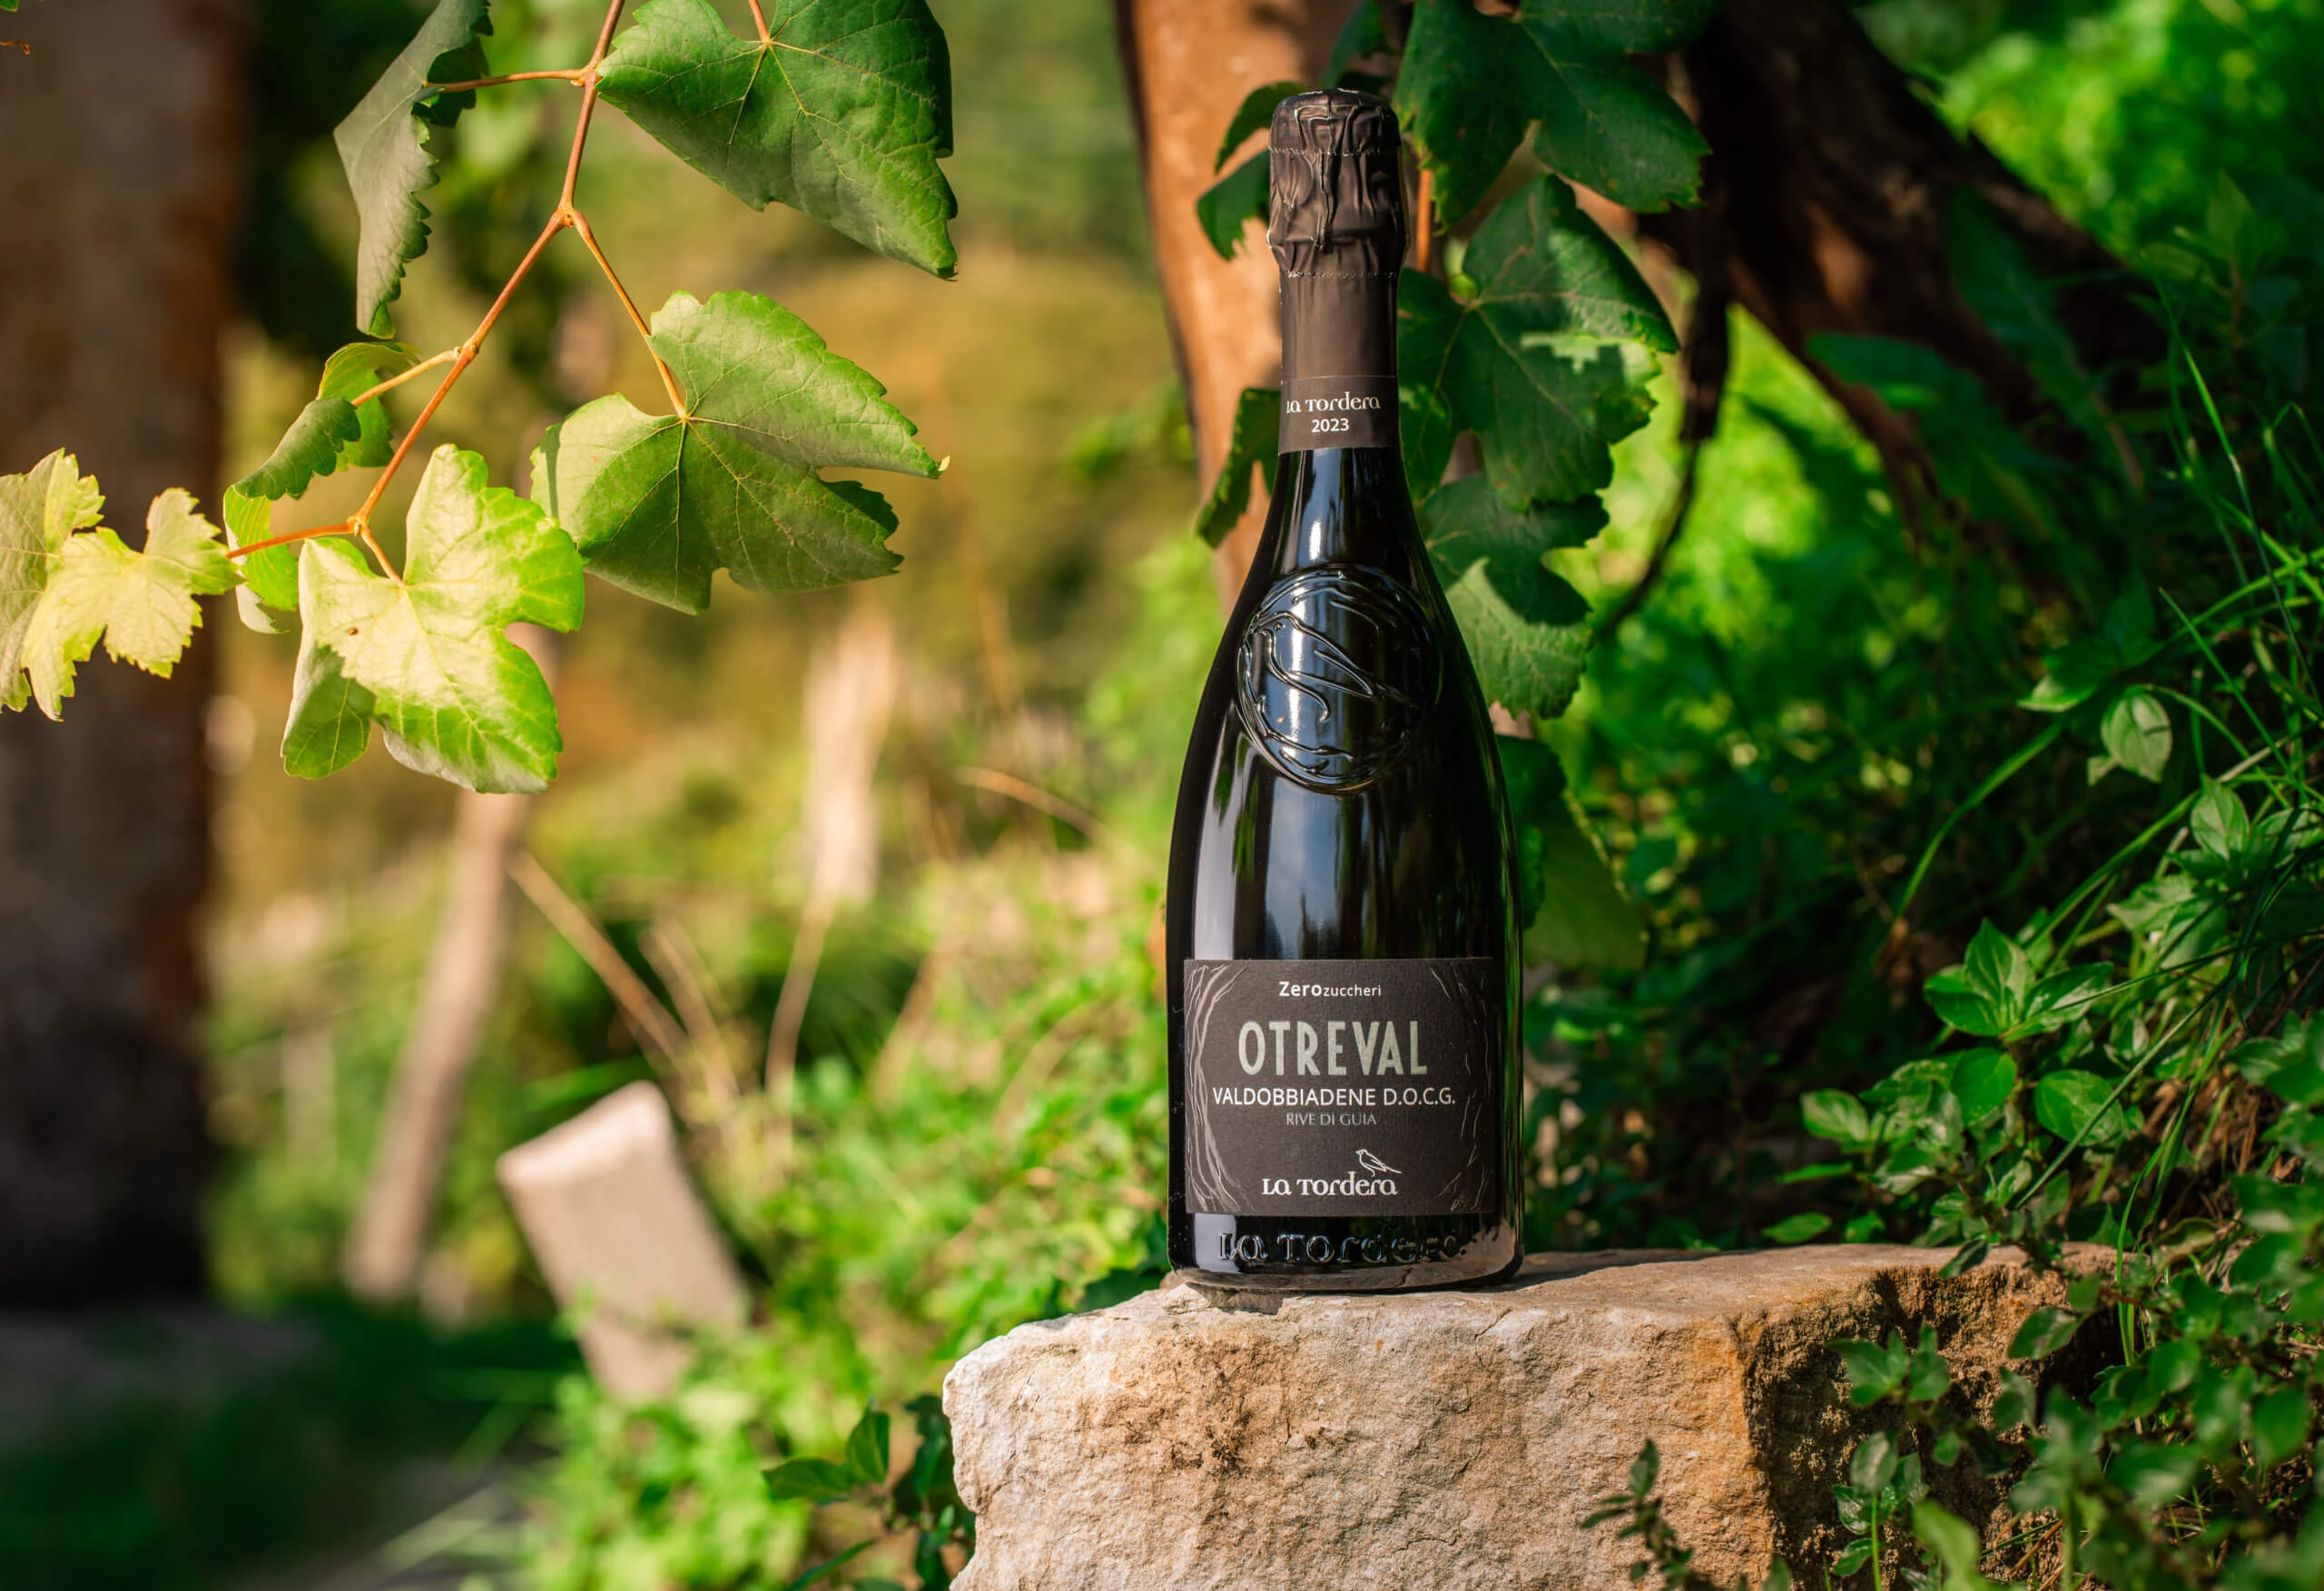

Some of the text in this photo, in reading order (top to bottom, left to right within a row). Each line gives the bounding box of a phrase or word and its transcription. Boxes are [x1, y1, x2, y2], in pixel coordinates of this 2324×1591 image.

[1305, 391, 1381, 412] Tordera
[1311, 417, 1350, 433] 2023
[1278, 980, 1382, 997] Zerozuccheri
[1237, 1020, 1428, 1076] OTREVAL
[1213, 1086, 1456, 1106] VALDOBBIADENE D.O.C.G.
[1285, 1113, 1377, 1126] RIVE DI GUIA
[1261, 1171, 1398, 1196] La Tordera
[1218, 1232, 1268, 1262] La
